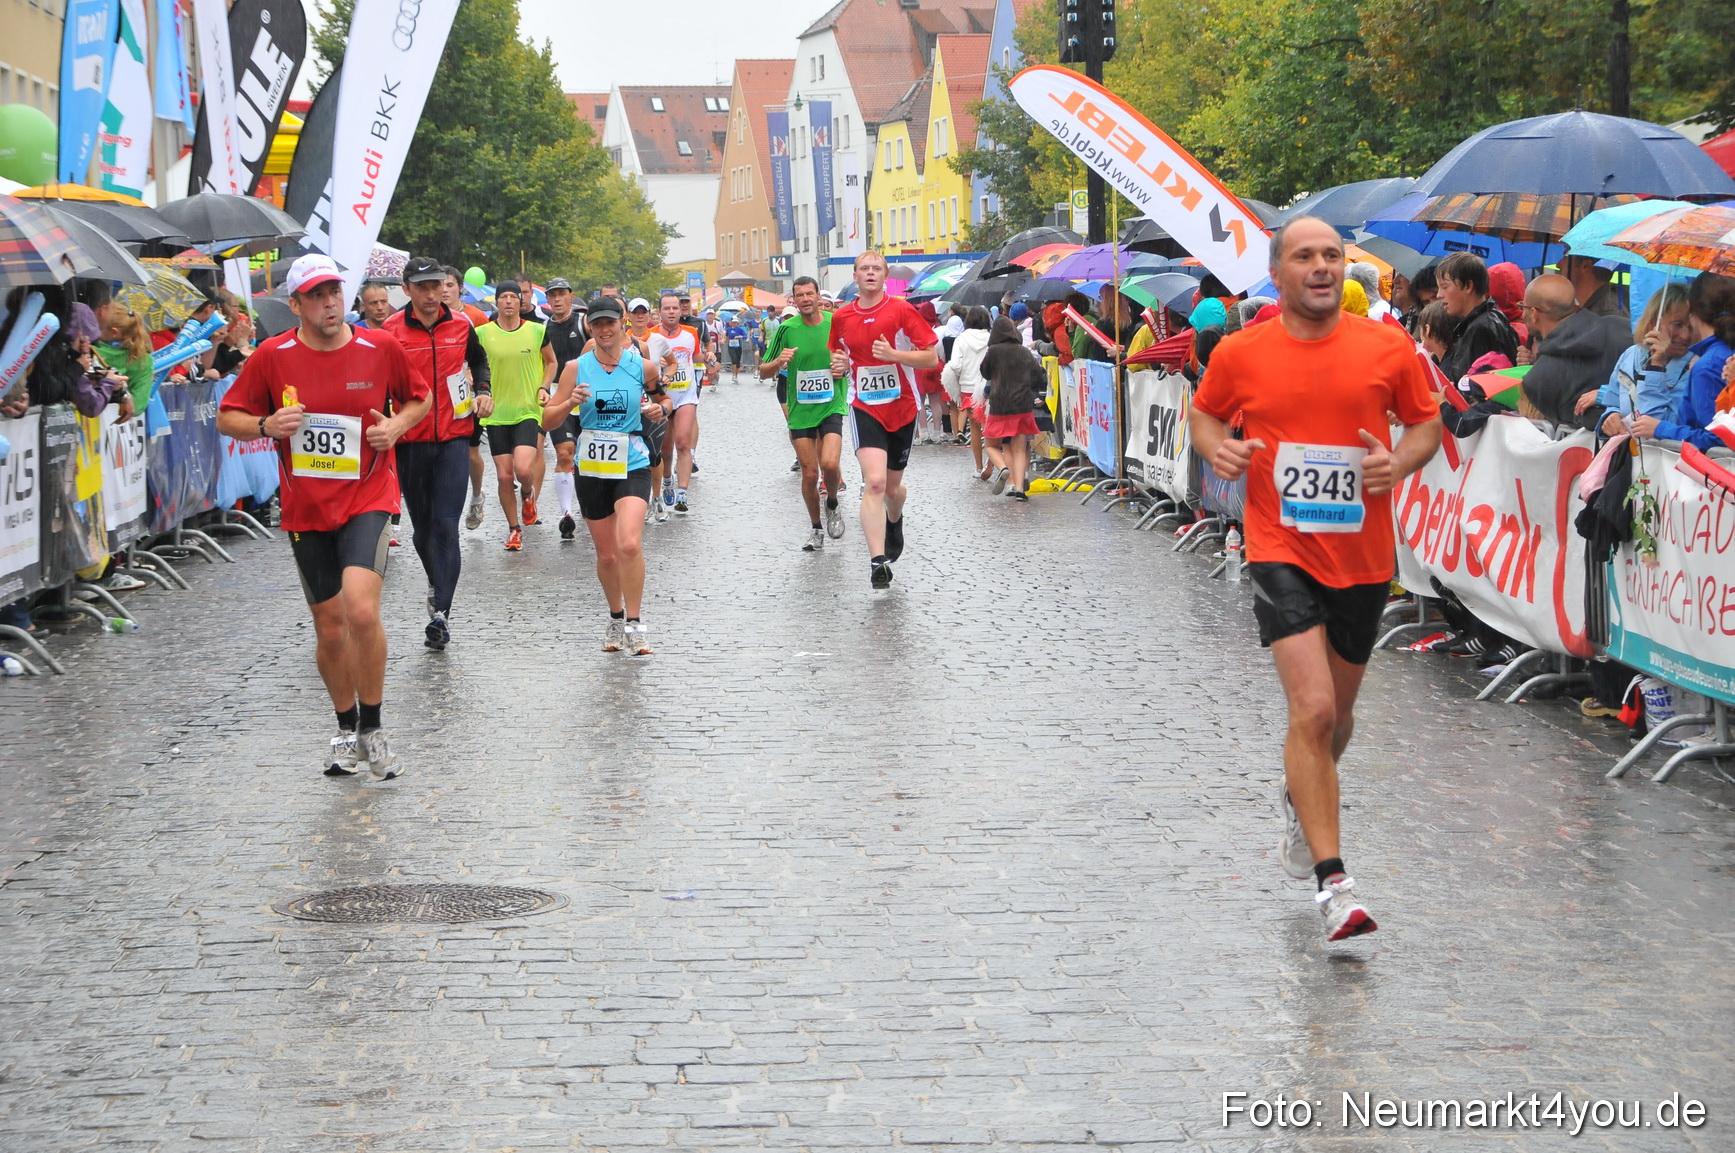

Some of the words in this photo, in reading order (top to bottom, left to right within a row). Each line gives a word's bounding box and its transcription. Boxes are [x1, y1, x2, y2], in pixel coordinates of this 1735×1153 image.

[266, 63, 287, 111] SWEDEN
[352, 148, 383, 226] Audi
[370, 73, 401, 141] BKK
[822, 152, 831, 198] RUPPERT
[1077, 195, 1087, 205] H
[772, 257, 790, 273] KL
[4, 325, 51, 378] ReiseCenter
[800, 378, 830, 392] 2256
[861, 374, 896, 391] 2416
[867, 391, 892, 400] Christian
[302, 429, 346, 455] 393
[588, 442, 618, 461] 812
[310, 458, 336, 469] Josef
[1283, 467, 1356, 501] 2343
[1290, 505, 1346, 521] Bernhard
